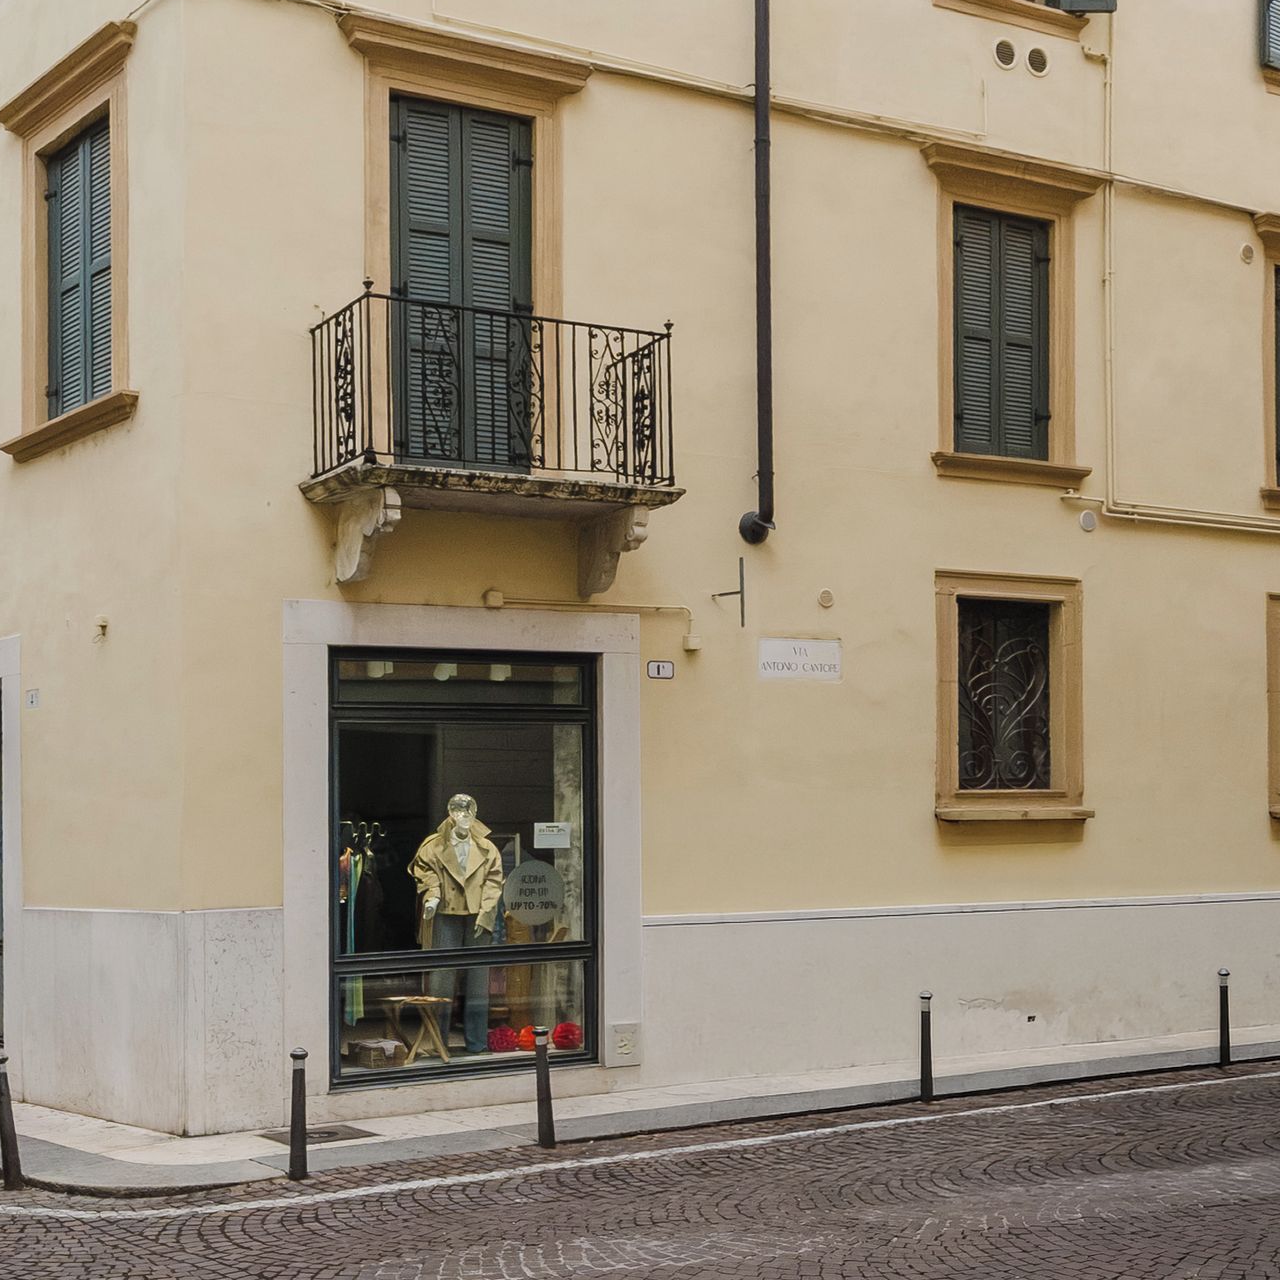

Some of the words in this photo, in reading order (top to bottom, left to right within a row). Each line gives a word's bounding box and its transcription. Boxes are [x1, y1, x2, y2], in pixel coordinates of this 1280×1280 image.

[792, 646, 808, 657] VIA
[510, 901, 522, 910] UP
[523, 901, 535, 910] TO
